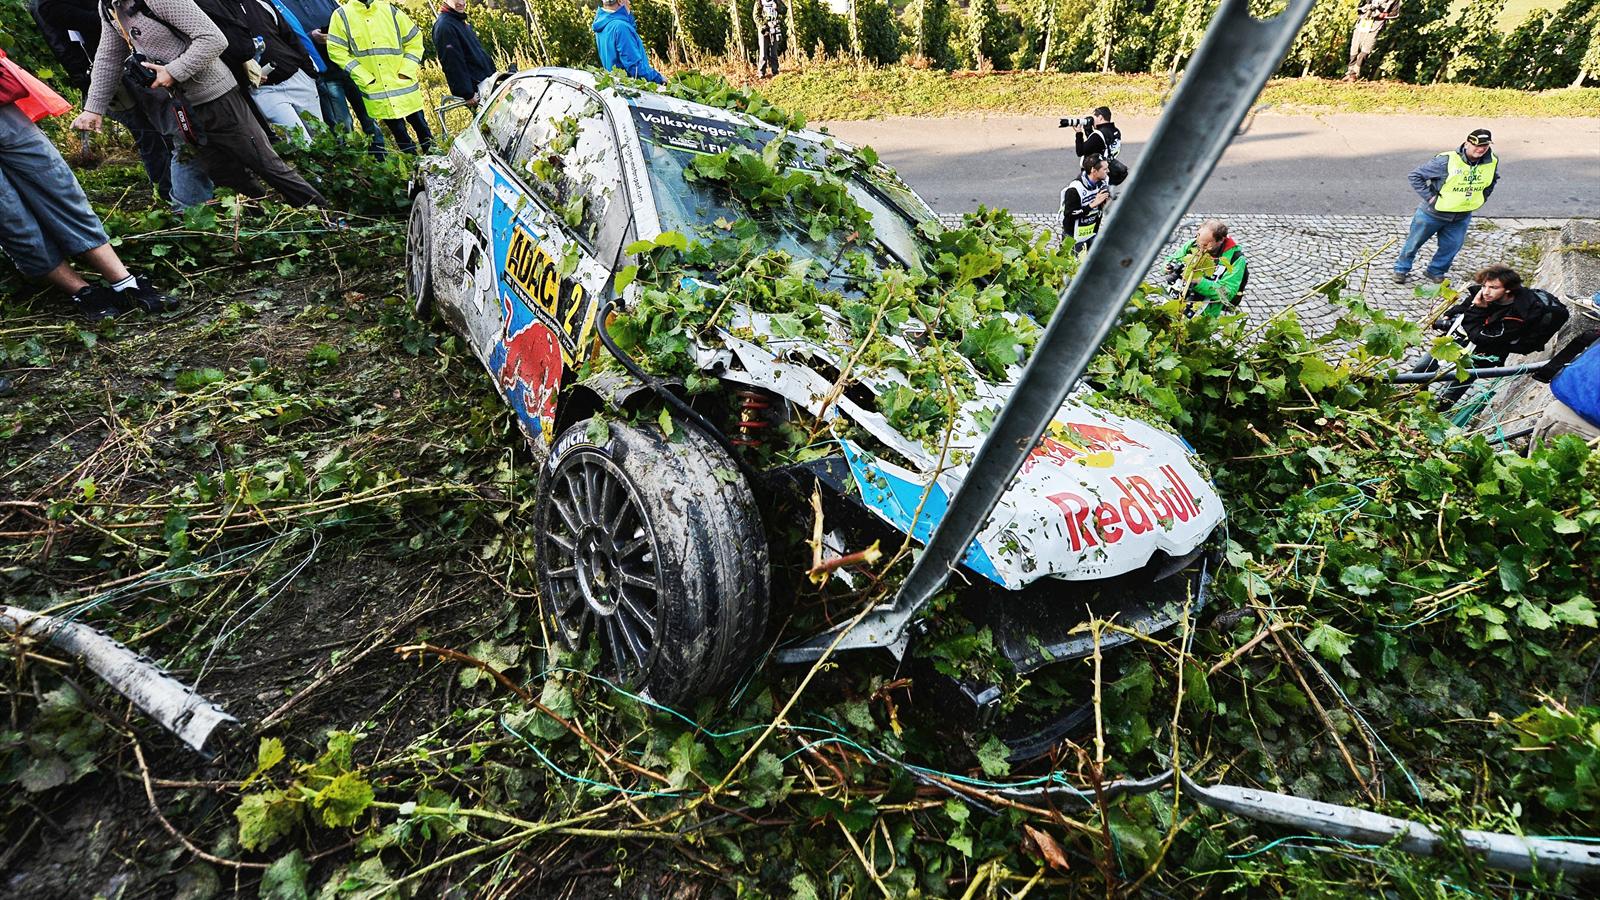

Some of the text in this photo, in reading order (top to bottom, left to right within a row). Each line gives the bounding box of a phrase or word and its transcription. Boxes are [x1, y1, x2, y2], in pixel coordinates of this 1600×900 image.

[640, 112, 736, 137] Volkswagen
[507, 232, 557, 308] ADAC
[563, 283, 583, 336] 2
